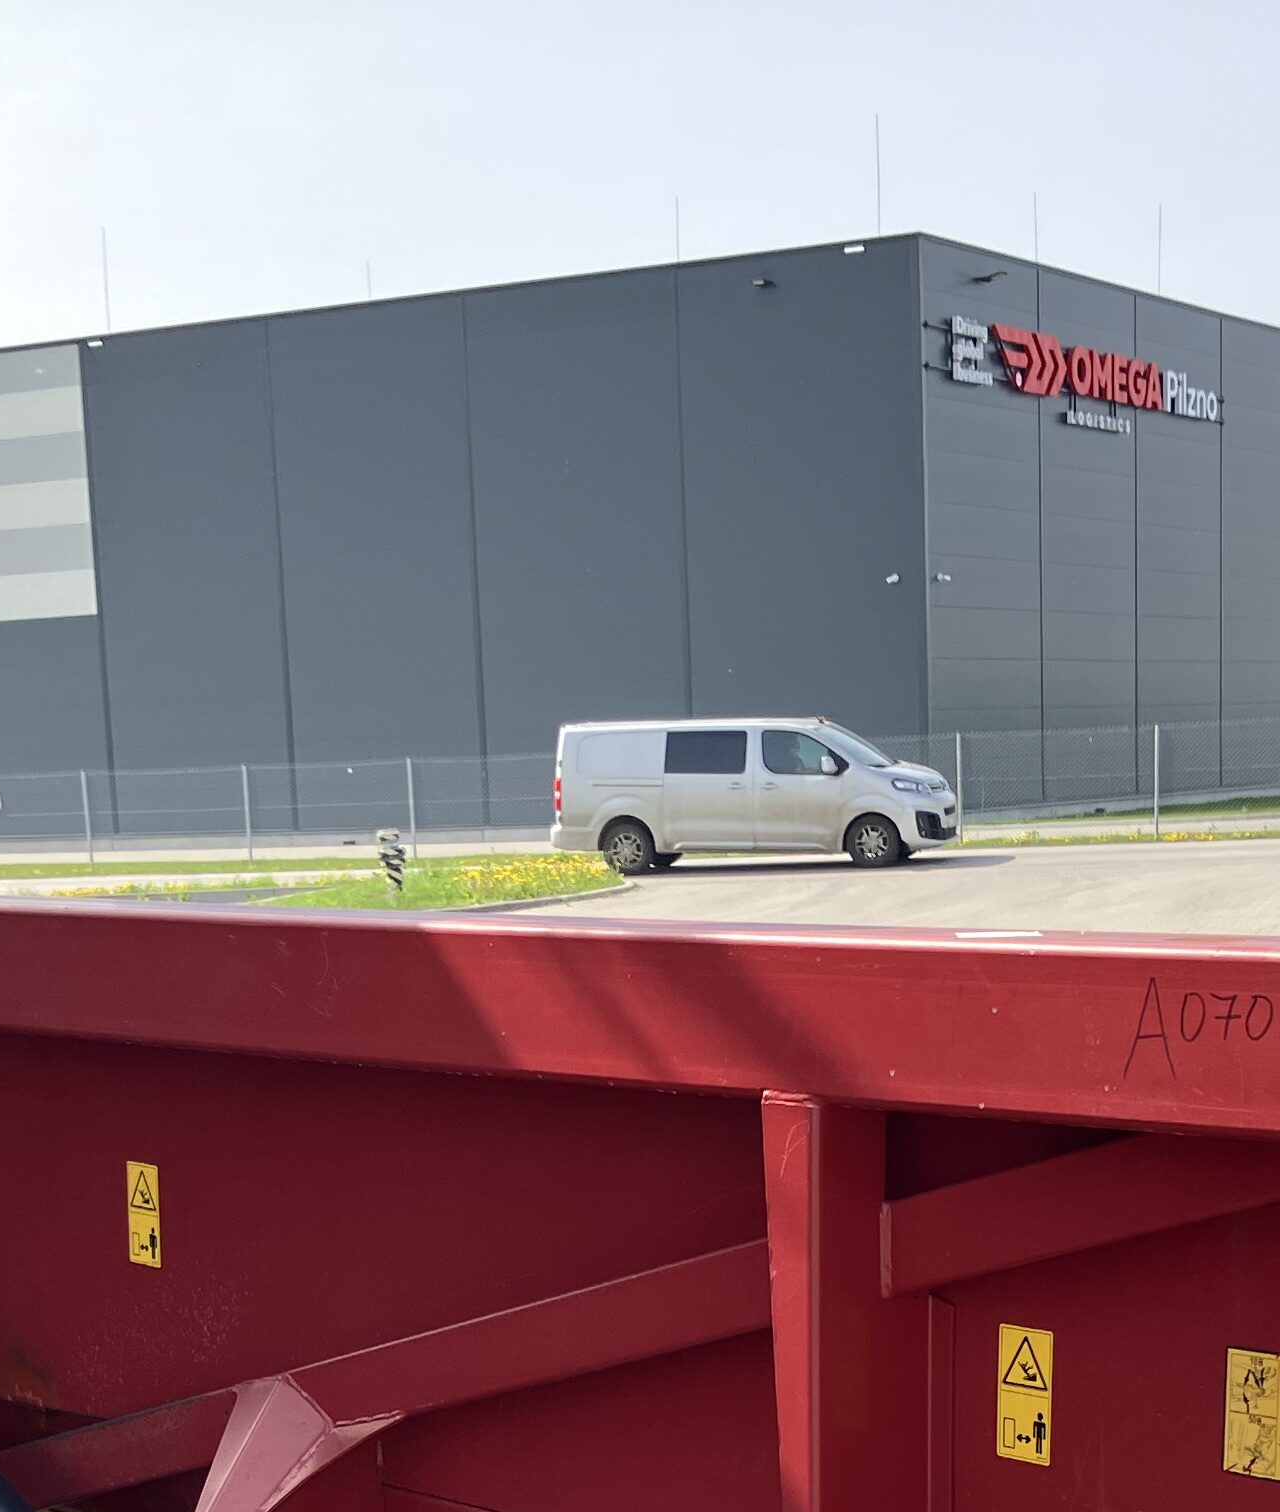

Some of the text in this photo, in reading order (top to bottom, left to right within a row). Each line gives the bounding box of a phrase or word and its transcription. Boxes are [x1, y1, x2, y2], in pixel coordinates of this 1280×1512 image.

[1070, 345, 1218, 421] OMEGA Pilzno
[1067, 410, 1131, 434] LOGISTICS
